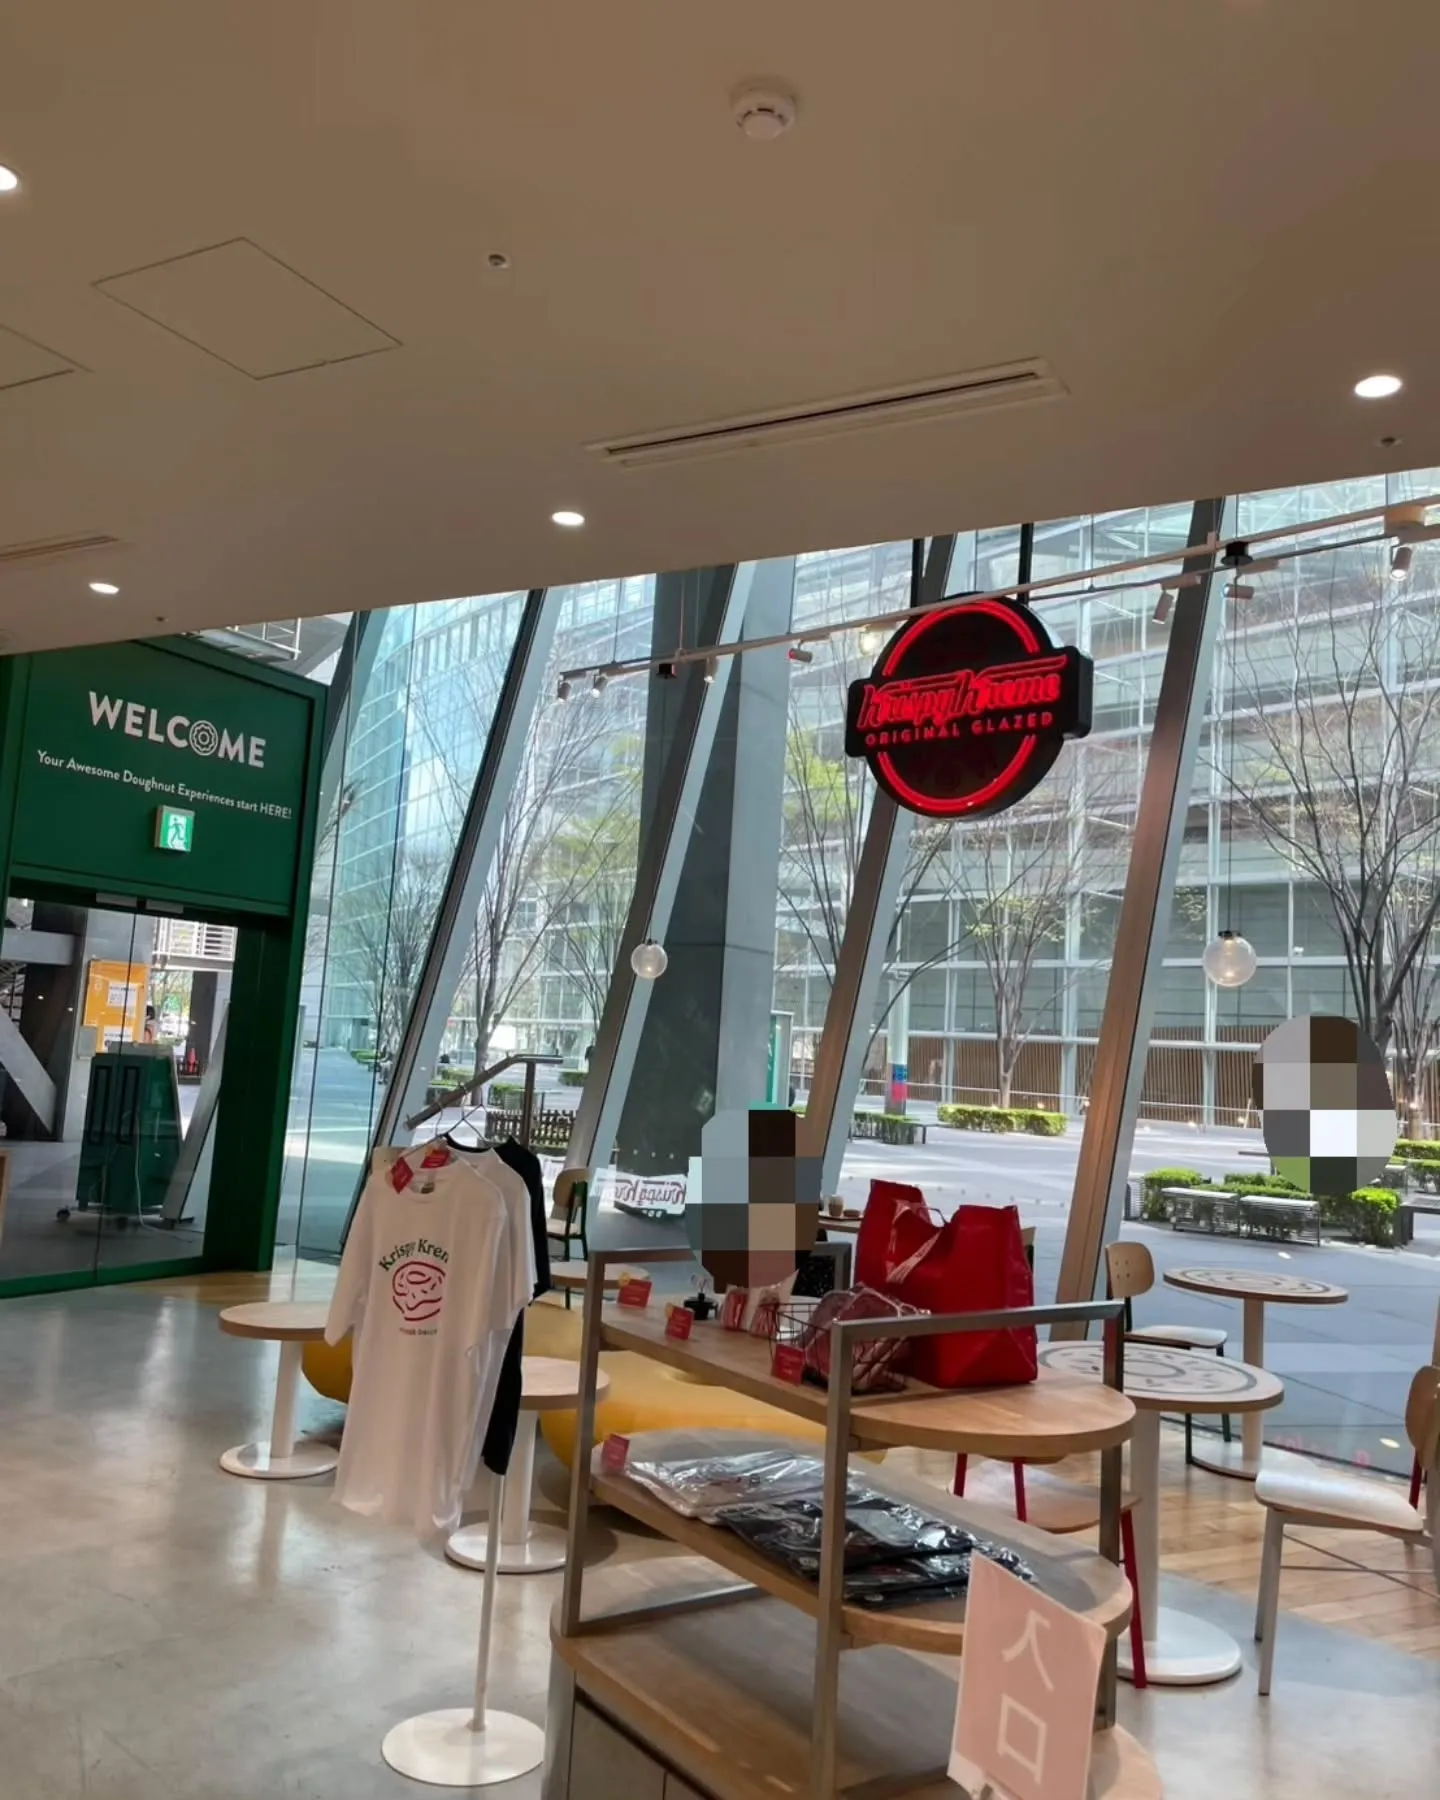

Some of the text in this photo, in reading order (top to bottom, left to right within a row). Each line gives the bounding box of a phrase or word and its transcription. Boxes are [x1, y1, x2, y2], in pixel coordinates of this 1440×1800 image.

[88, 690, 267, 769] WELCOME
[864, 711, 1054, 746] ORIGINAL GLAZED
[37, 749, 293, 819] Your Awesome Doughnut Experiences start HERE!
